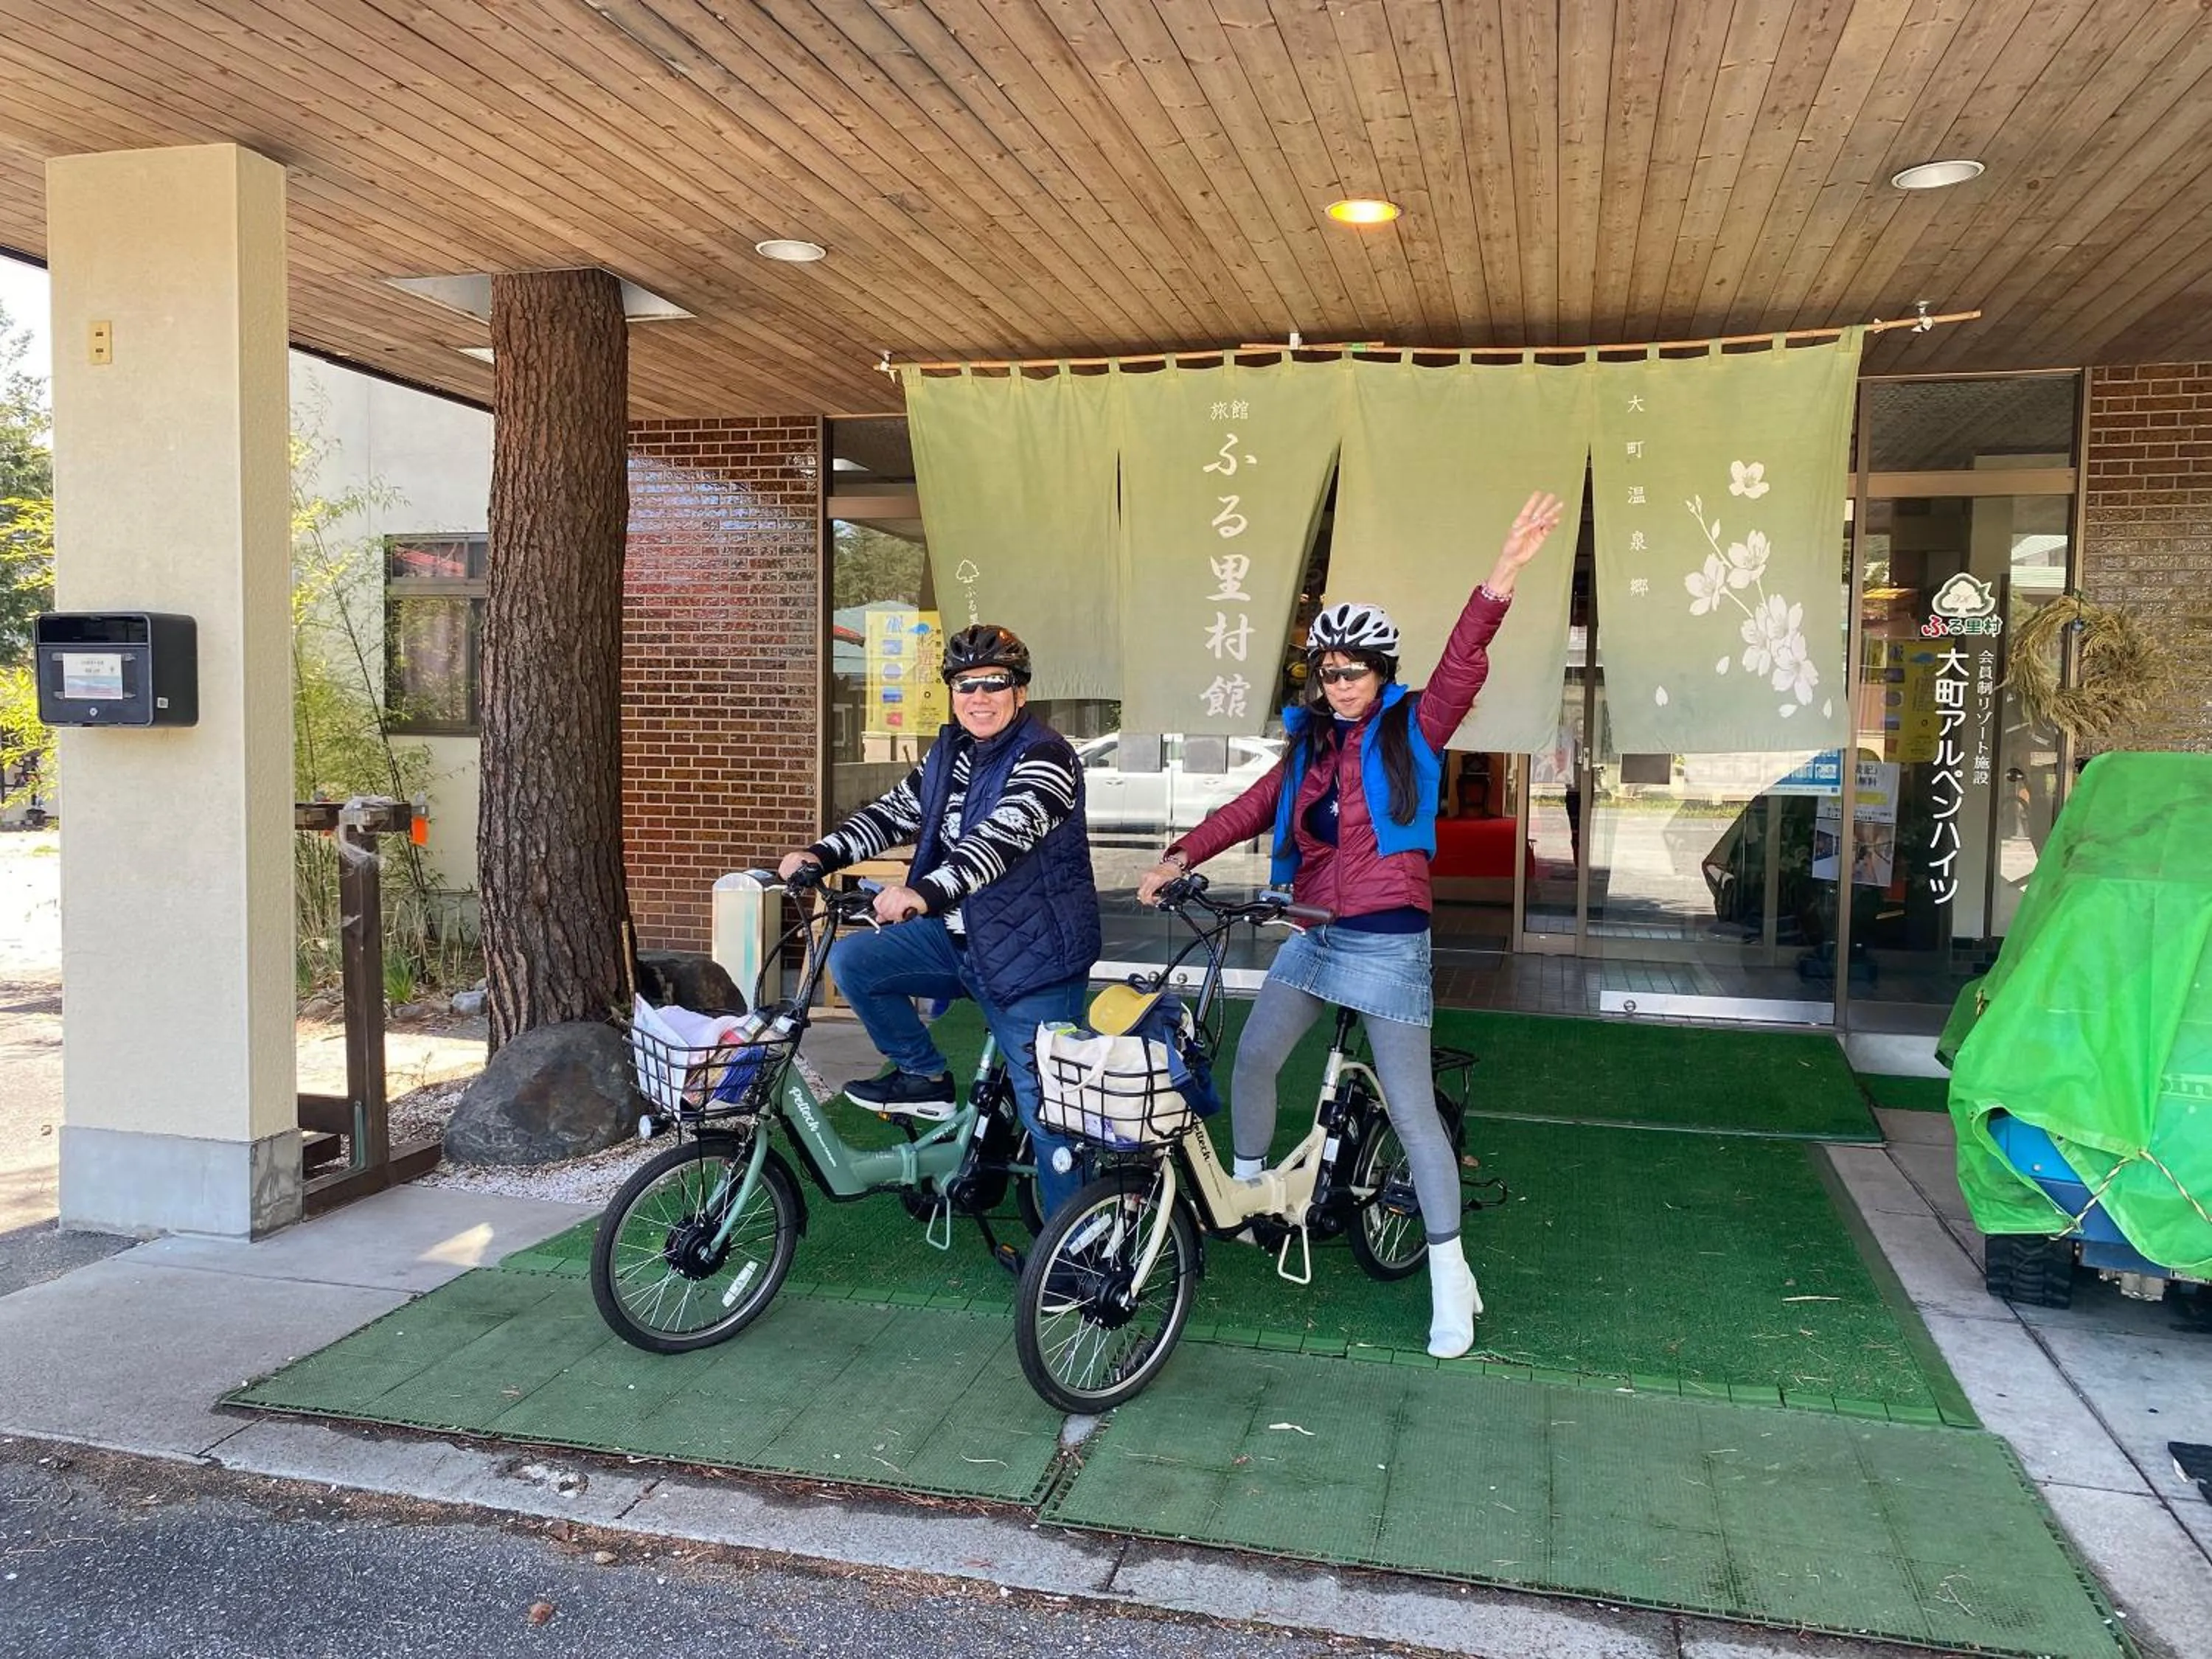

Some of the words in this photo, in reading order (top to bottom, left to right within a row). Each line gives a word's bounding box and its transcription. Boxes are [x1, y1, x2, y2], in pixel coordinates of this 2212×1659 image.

[1209, 400, 1249, 420] 旅館
[1627, 394, 1649, 597] 大町温泉郷
[1198, 433, 1257, 718] ふる里村館
[964, 586, 979, 630] ふる里
[1921, 614, 2003, 638] ふる里村
[1929, 648, 1970, 905] 大町アルペンハイツ
[788, 1086, 819, 1131] Peltech
[1192, 1113, 1211, 1162] eltech
